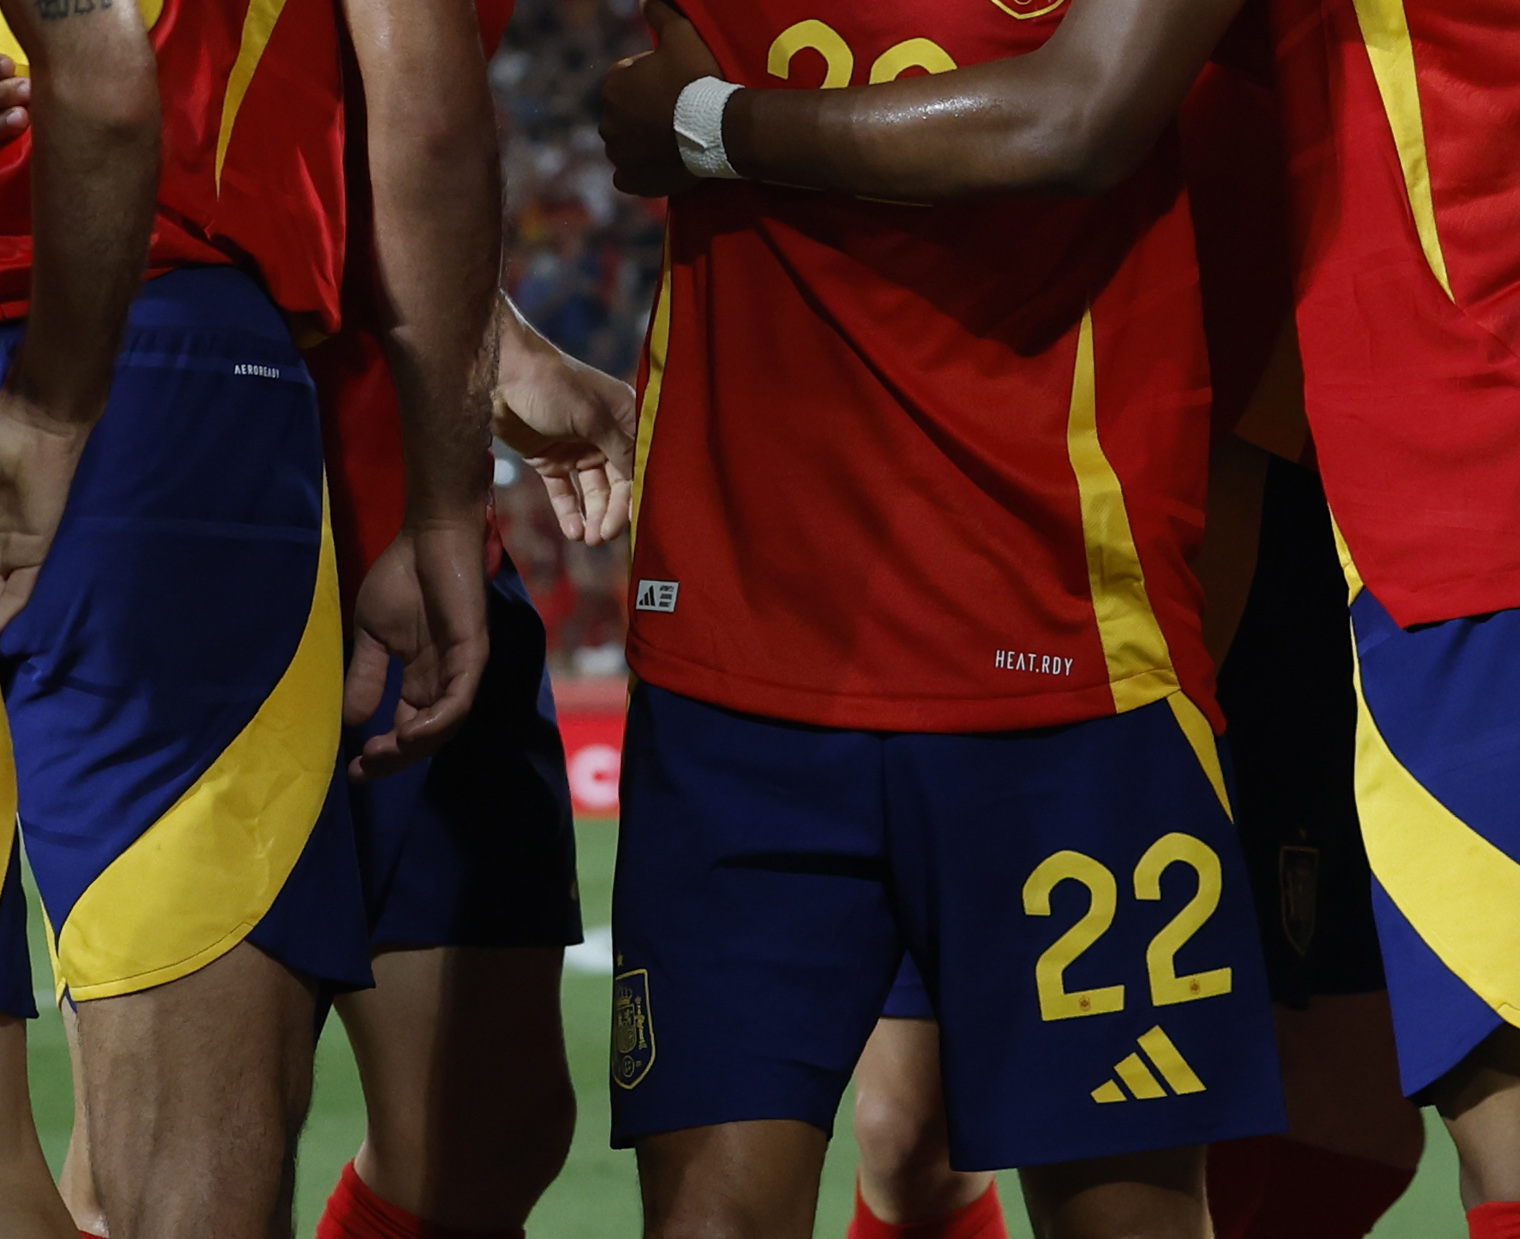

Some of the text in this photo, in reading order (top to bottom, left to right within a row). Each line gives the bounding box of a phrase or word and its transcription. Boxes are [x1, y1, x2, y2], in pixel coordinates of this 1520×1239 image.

[234, 364, 280, 379] AEROREADY
[995, 649, 1073, 676] HEAT.RDY
[1022, 831, 1232, 1021] 22
